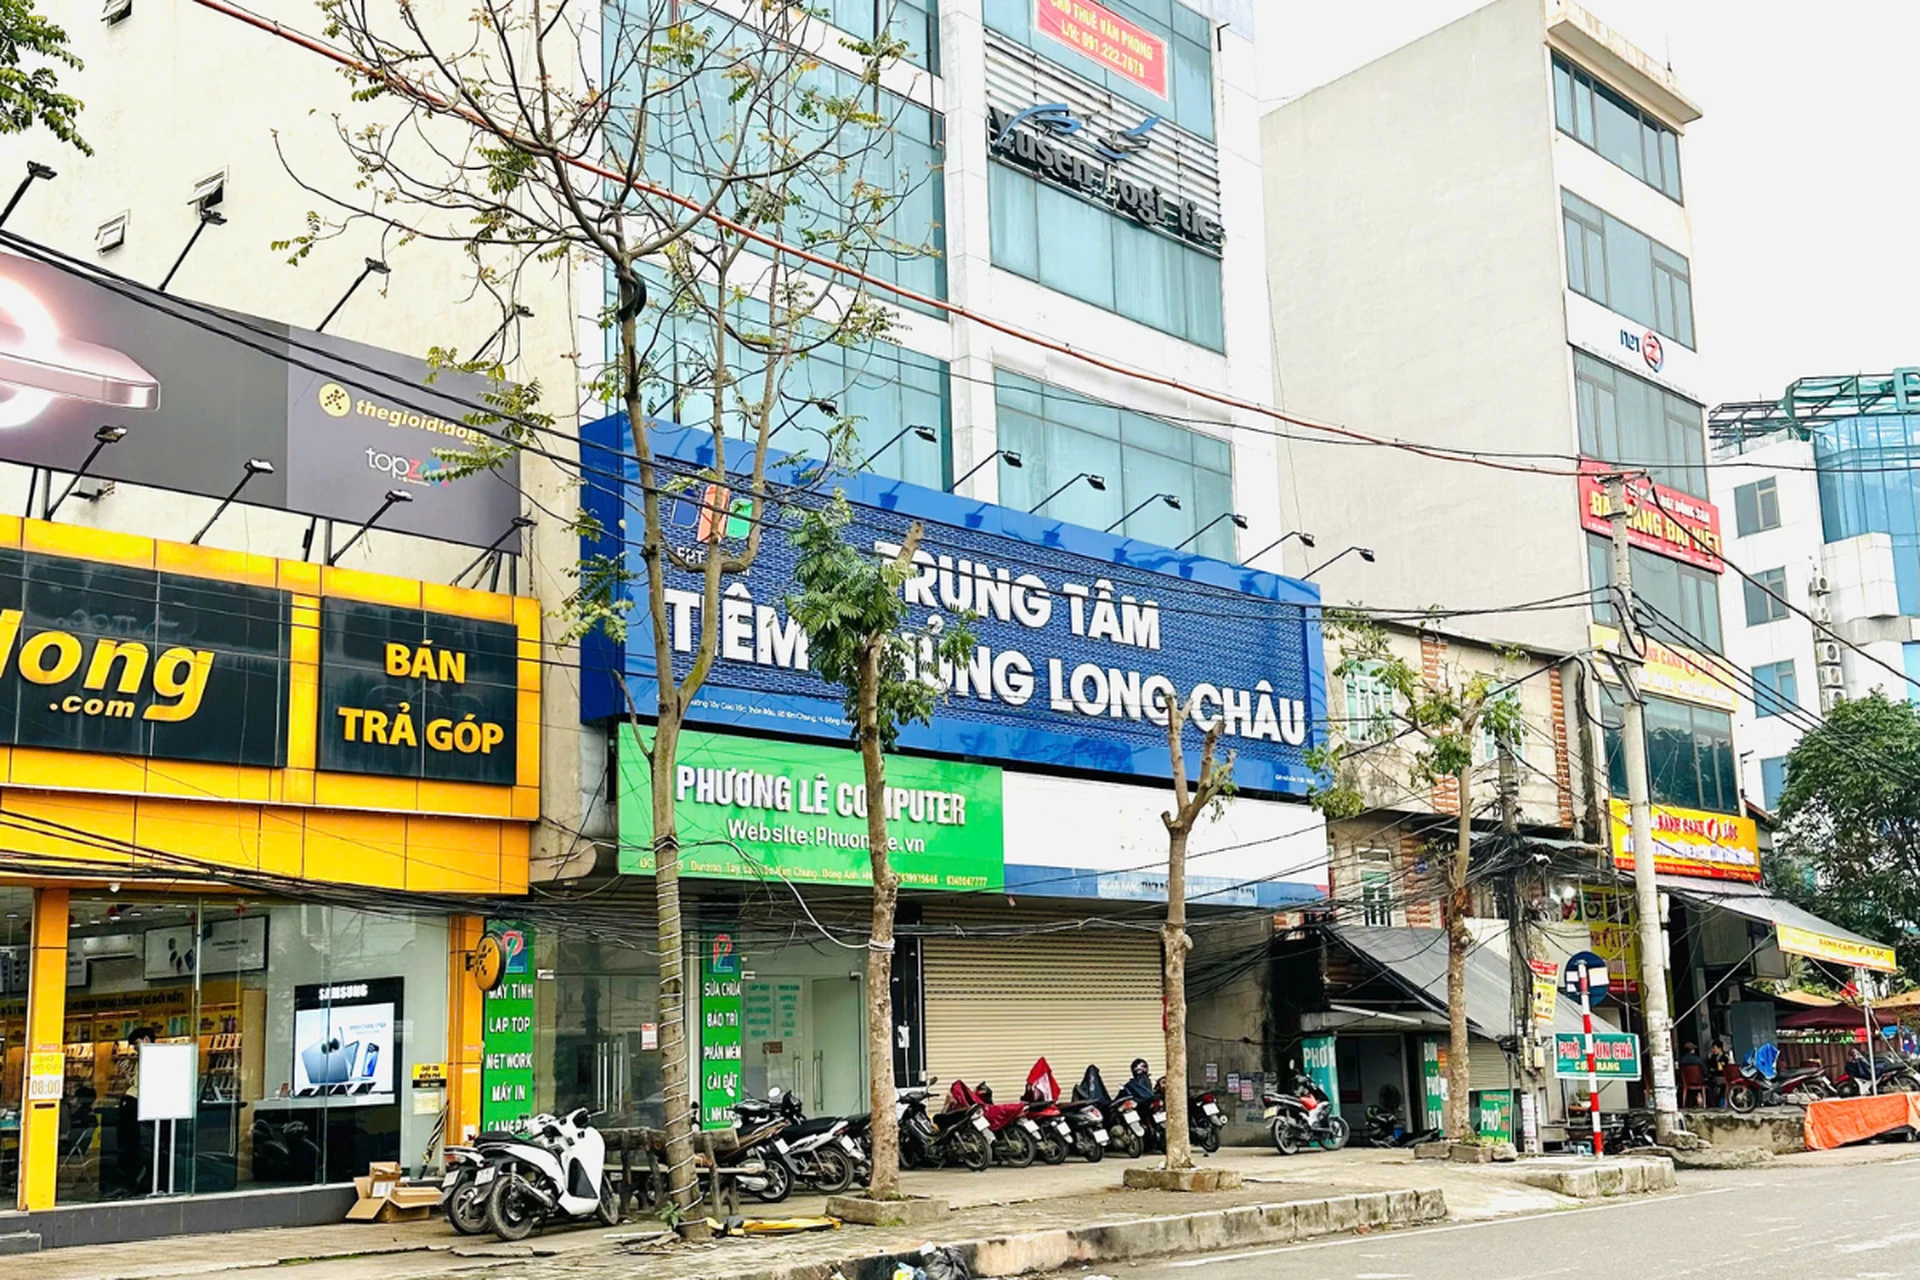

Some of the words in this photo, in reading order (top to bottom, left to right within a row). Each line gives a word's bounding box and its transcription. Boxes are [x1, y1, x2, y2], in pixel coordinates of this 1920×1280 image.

[1063, 578, 1161, 651] TÂM
[385, 640, 466, 685] BÁN
[49, 694, 136, 719] .com
[1048, 657, 1170, 727] LONG
[1189, 680, 1306, 746] CHÂU
[337, 701, 417, 748] TRẢ
[425, 717, 505, 755] GÓP
[675, 765, 791, 813] PHƯƠNG
[799, 773, 829, 816] LÊ
[318, 983, 369, 1001] SAMSUNG
[511, 983, 534, 1000] TÍNH
[489, 1017, 509, 1032] LAP
[511, 1016, 531, 1032] TOP
[1302, 1040, 1327, 1069] PHỞ
[1558, 1036, 1580, 1060] PHỞ
[1594, 1038, 1611, 1060] ÚN
[1612, 1036, 1635, 1060] CHẢ
[31, 1080, 61, 1096] 08:00
[492, 1081, 511, 1102] MÁY
[515, 1085, 525, 1100] IN
[1481, 1103, 1500, 1131] PHỞ
